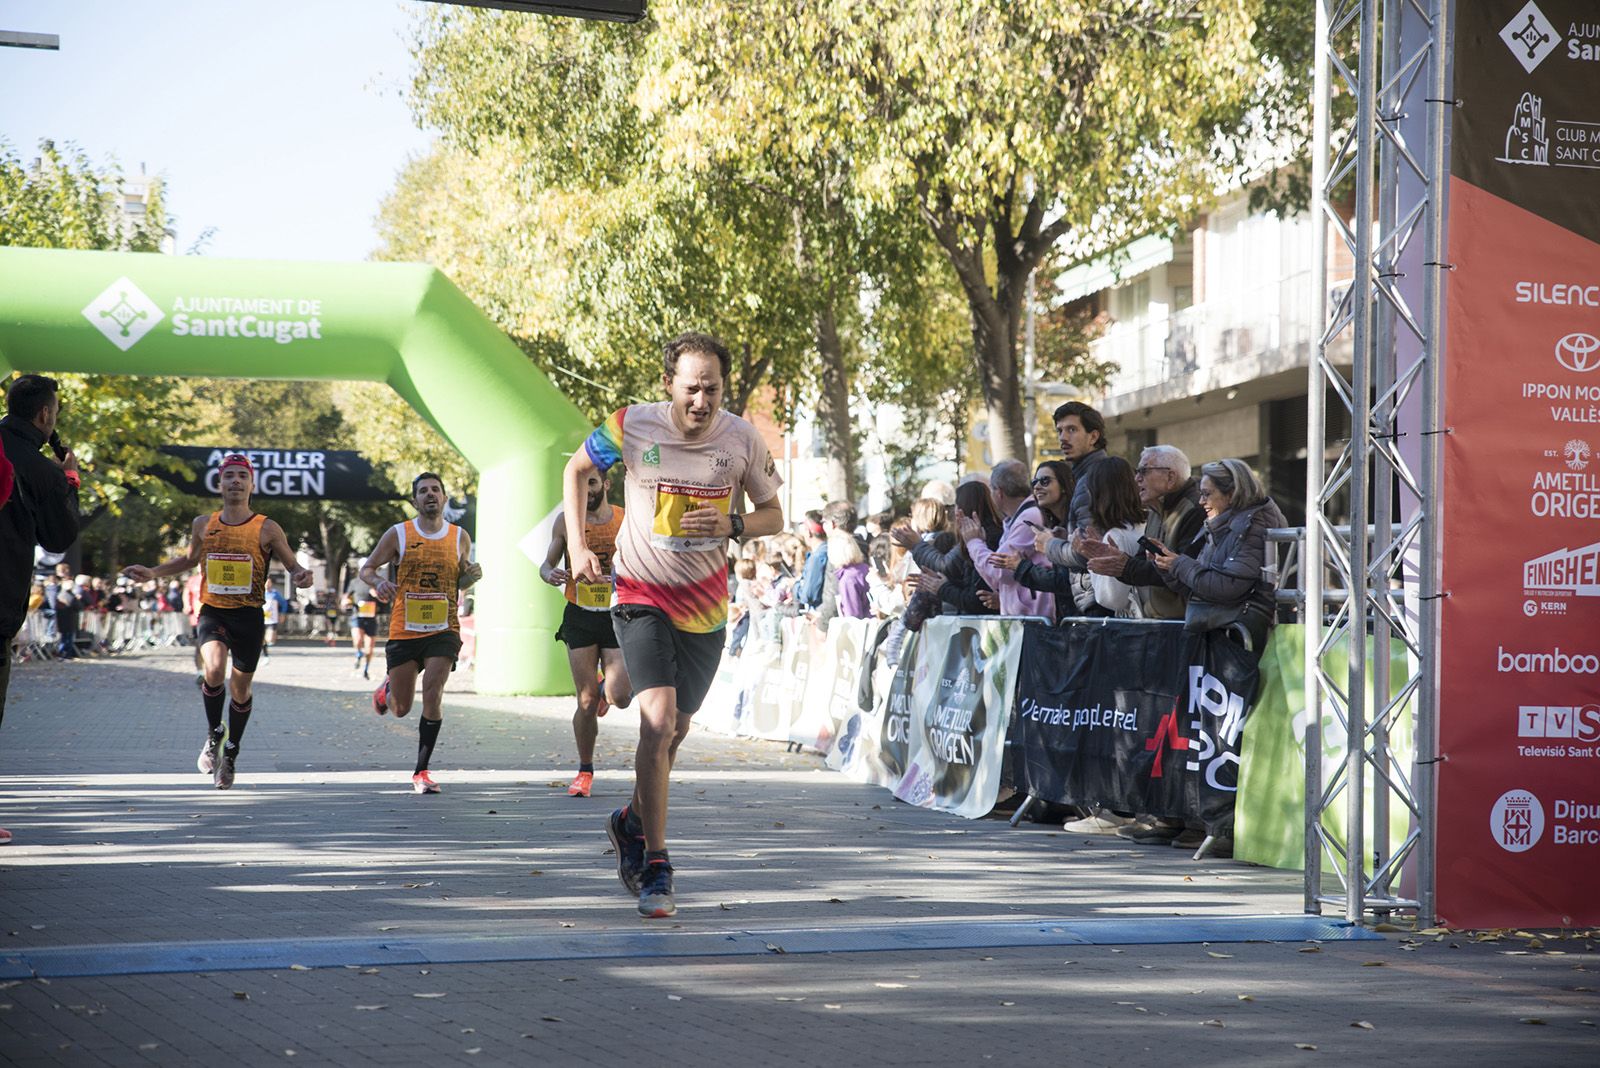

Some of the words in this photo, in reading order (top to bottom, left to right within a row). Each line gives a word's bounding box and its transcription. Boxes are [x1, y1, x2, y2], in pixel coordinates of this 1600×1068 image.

[1556, 128, 1586, 142] CLUB
[1556, 146, 1589, 160] SANT
[1515, 281, 1600, 306] SILENC
[172, 297, 294, 314] AJUNTAMENT
[298, 300, 321, 315] DE
[172, 313, 322, 344] SantCugat
[1522, 383, 1571, 399] IPPON
[1551, 404, 1600, 423] VALLÈ
[204, 468, 325, 496] OIGEN
[1541, 602, 1567, 610] KERN
[1498, 646, 1599, 674] bamboo
[1518, 745, 1566, 757] Televisió
[1568, 746, 1593, 757] Sant
[1554, 825, 1600, 844] Barc
